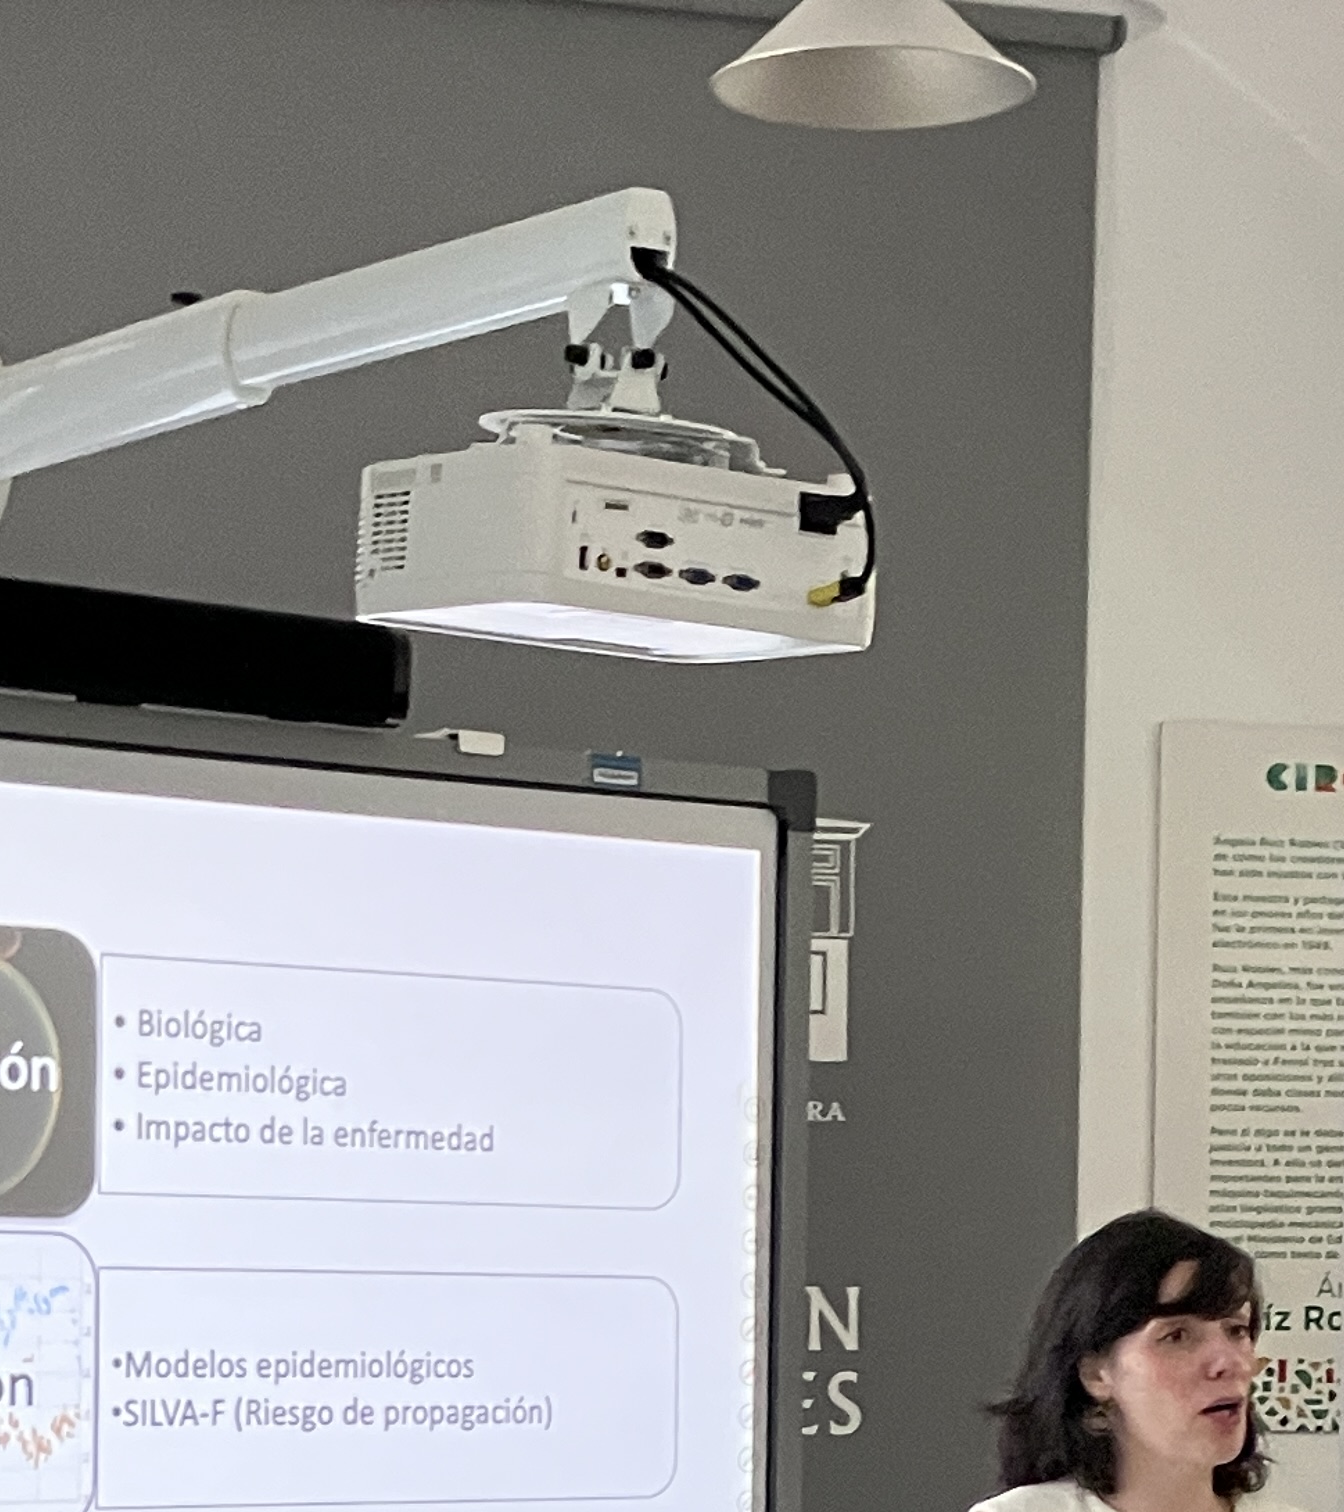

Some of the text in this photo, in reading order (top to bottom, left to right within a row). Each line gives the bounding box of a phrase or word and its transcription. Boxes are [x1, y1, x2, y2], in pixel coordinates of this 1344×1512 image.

[136, 1009, 263, 1049] Biológica
[136, 1061, 349, 1103] Epidemiológica
[806, 1100, 846, 1122] RA
[136, 1112, 495, 1155] Impacto de la enfermedad
[804, 1285, 861, 1351] N
[123, 1349, 475, 1389] Modelos epidemiológicos
[123, 1395, 553, 1436] SILVA-F (Riesgo de propagación)
